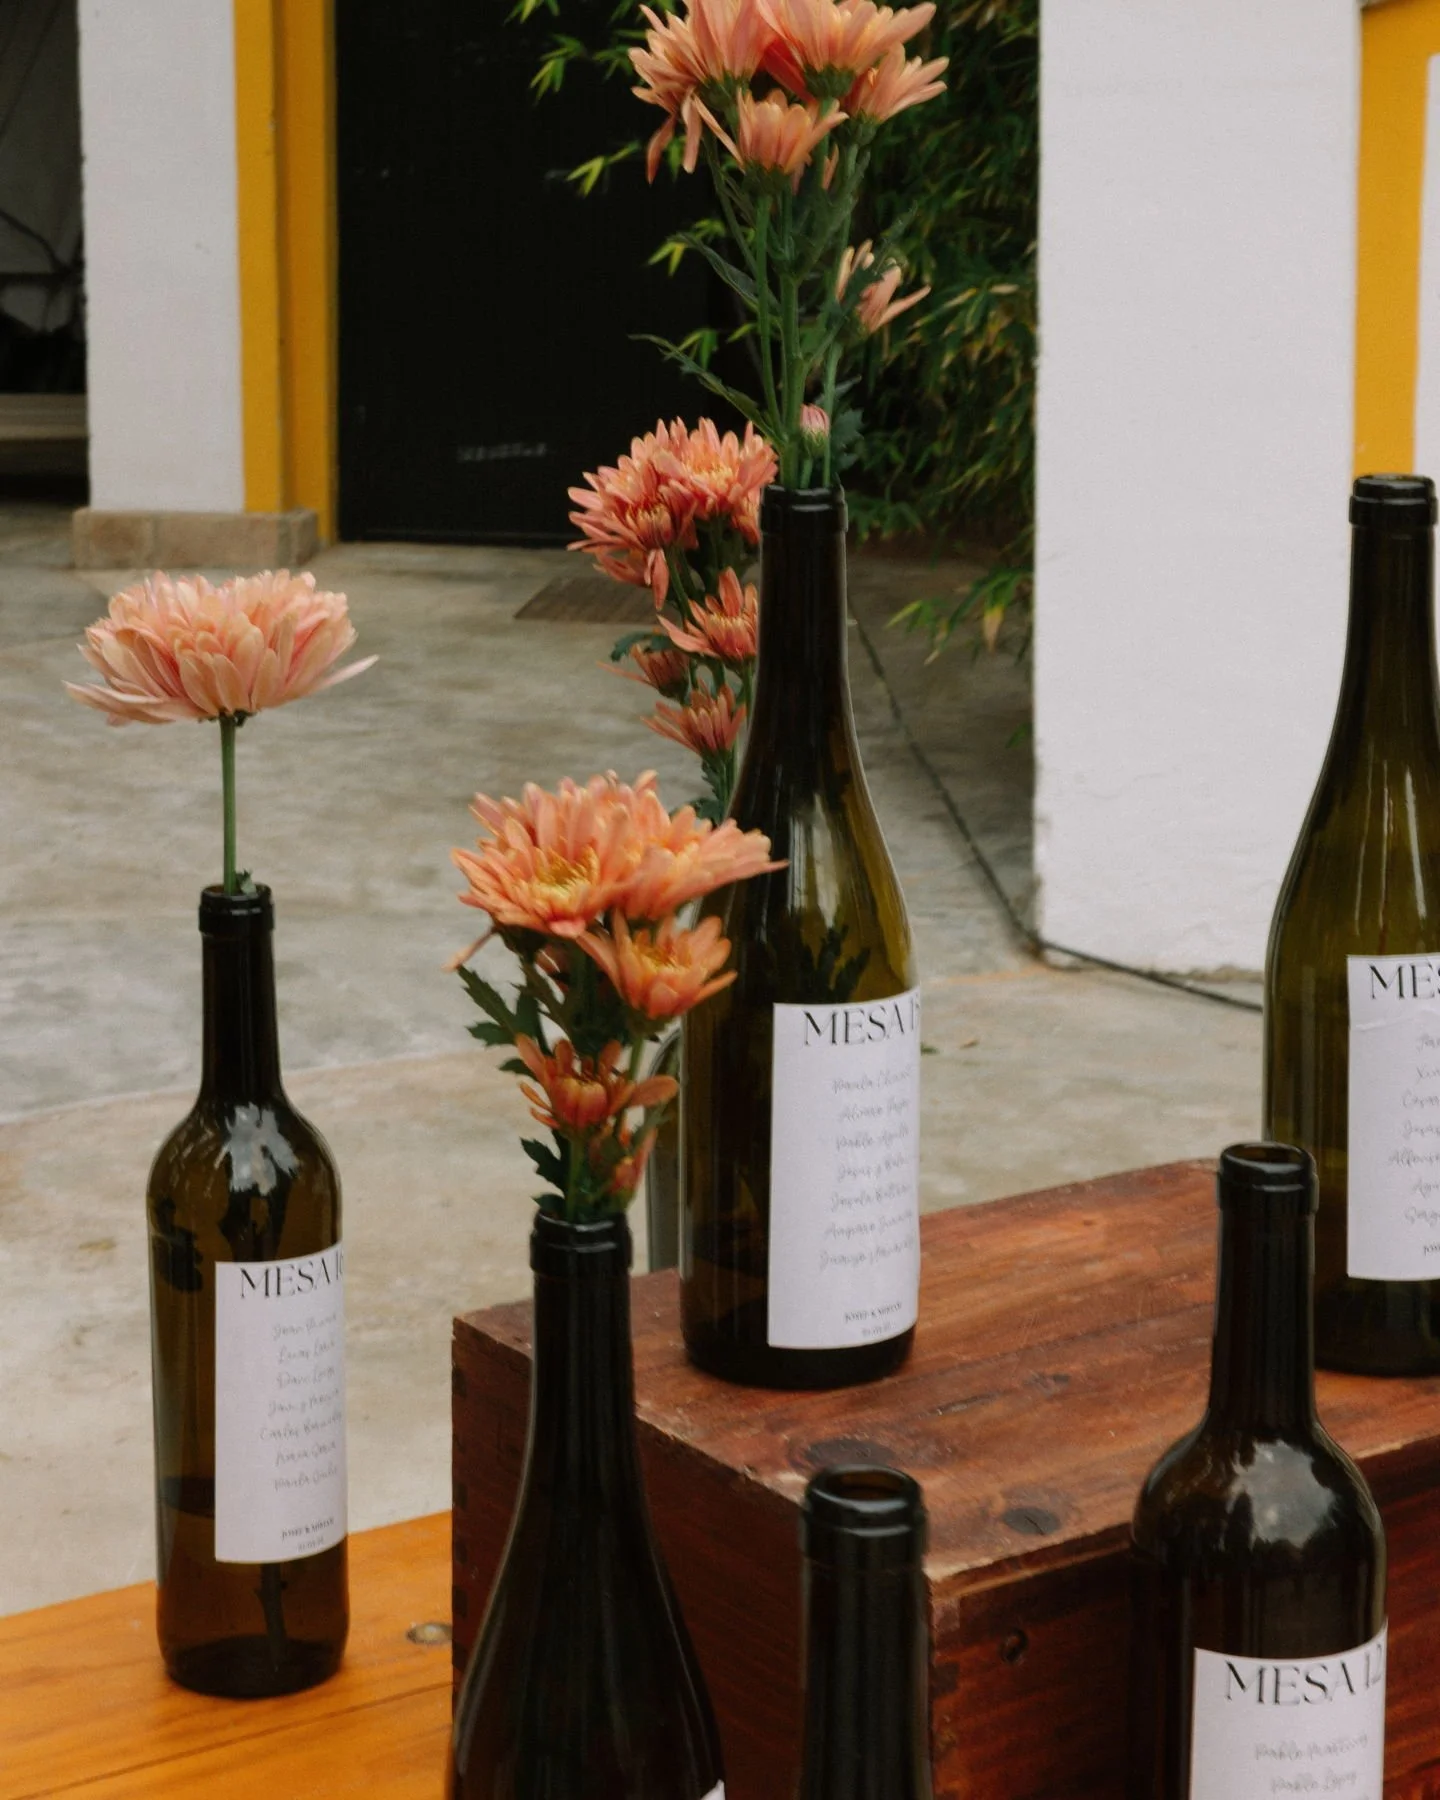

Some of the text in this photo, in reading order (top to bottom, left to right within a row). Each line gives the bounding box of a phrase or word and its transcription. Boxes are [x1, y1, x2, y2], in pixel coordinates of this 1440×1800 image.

[1369, 963, 1440, 1000] ME
[803, 1000, 905, 1047] MESA
[240, 1257, 331, 1299] MESA
[1225, 1659, 1356, 1706] MESA
